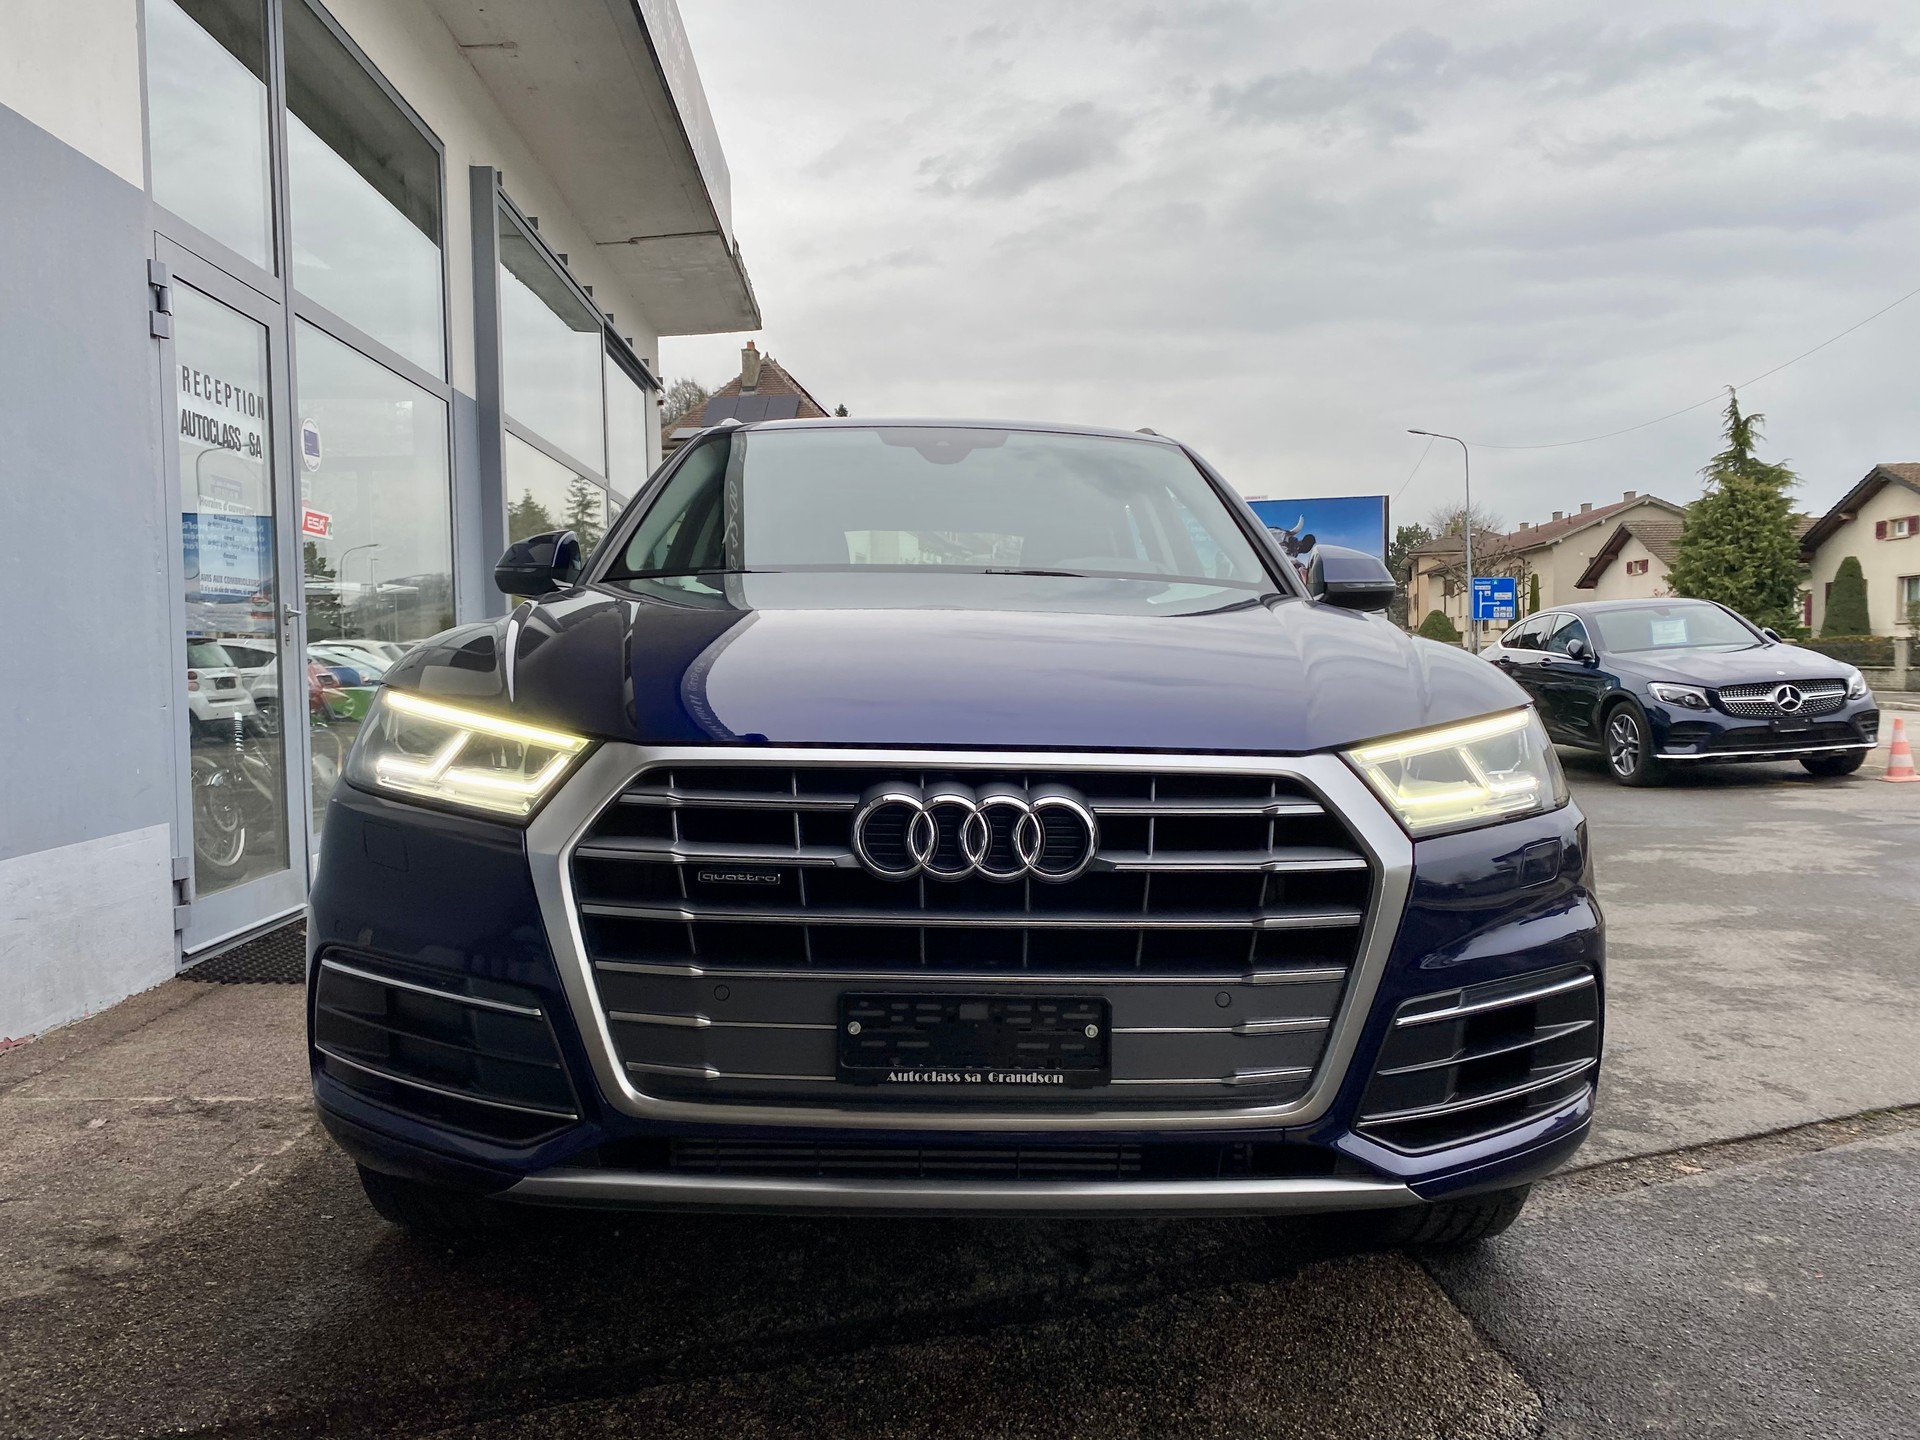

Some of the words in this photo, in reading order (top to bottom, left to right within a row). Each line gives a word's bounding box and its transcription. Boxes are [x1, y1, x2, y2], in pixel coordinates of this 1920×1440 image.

[182, 365, 264, 420] RECEPTION
[181, 408, 241, 451] AUTOCLASS
[249, 432, 262, 459] SA
[306, 516, 325, 532] ESA
[702, 873, 777, 882] quattro
[886, 1070, 961, 1082] Autoclass
[964, 1072, 982, 1082] sa
[987, 1071, 1064, 1084] Grandson
